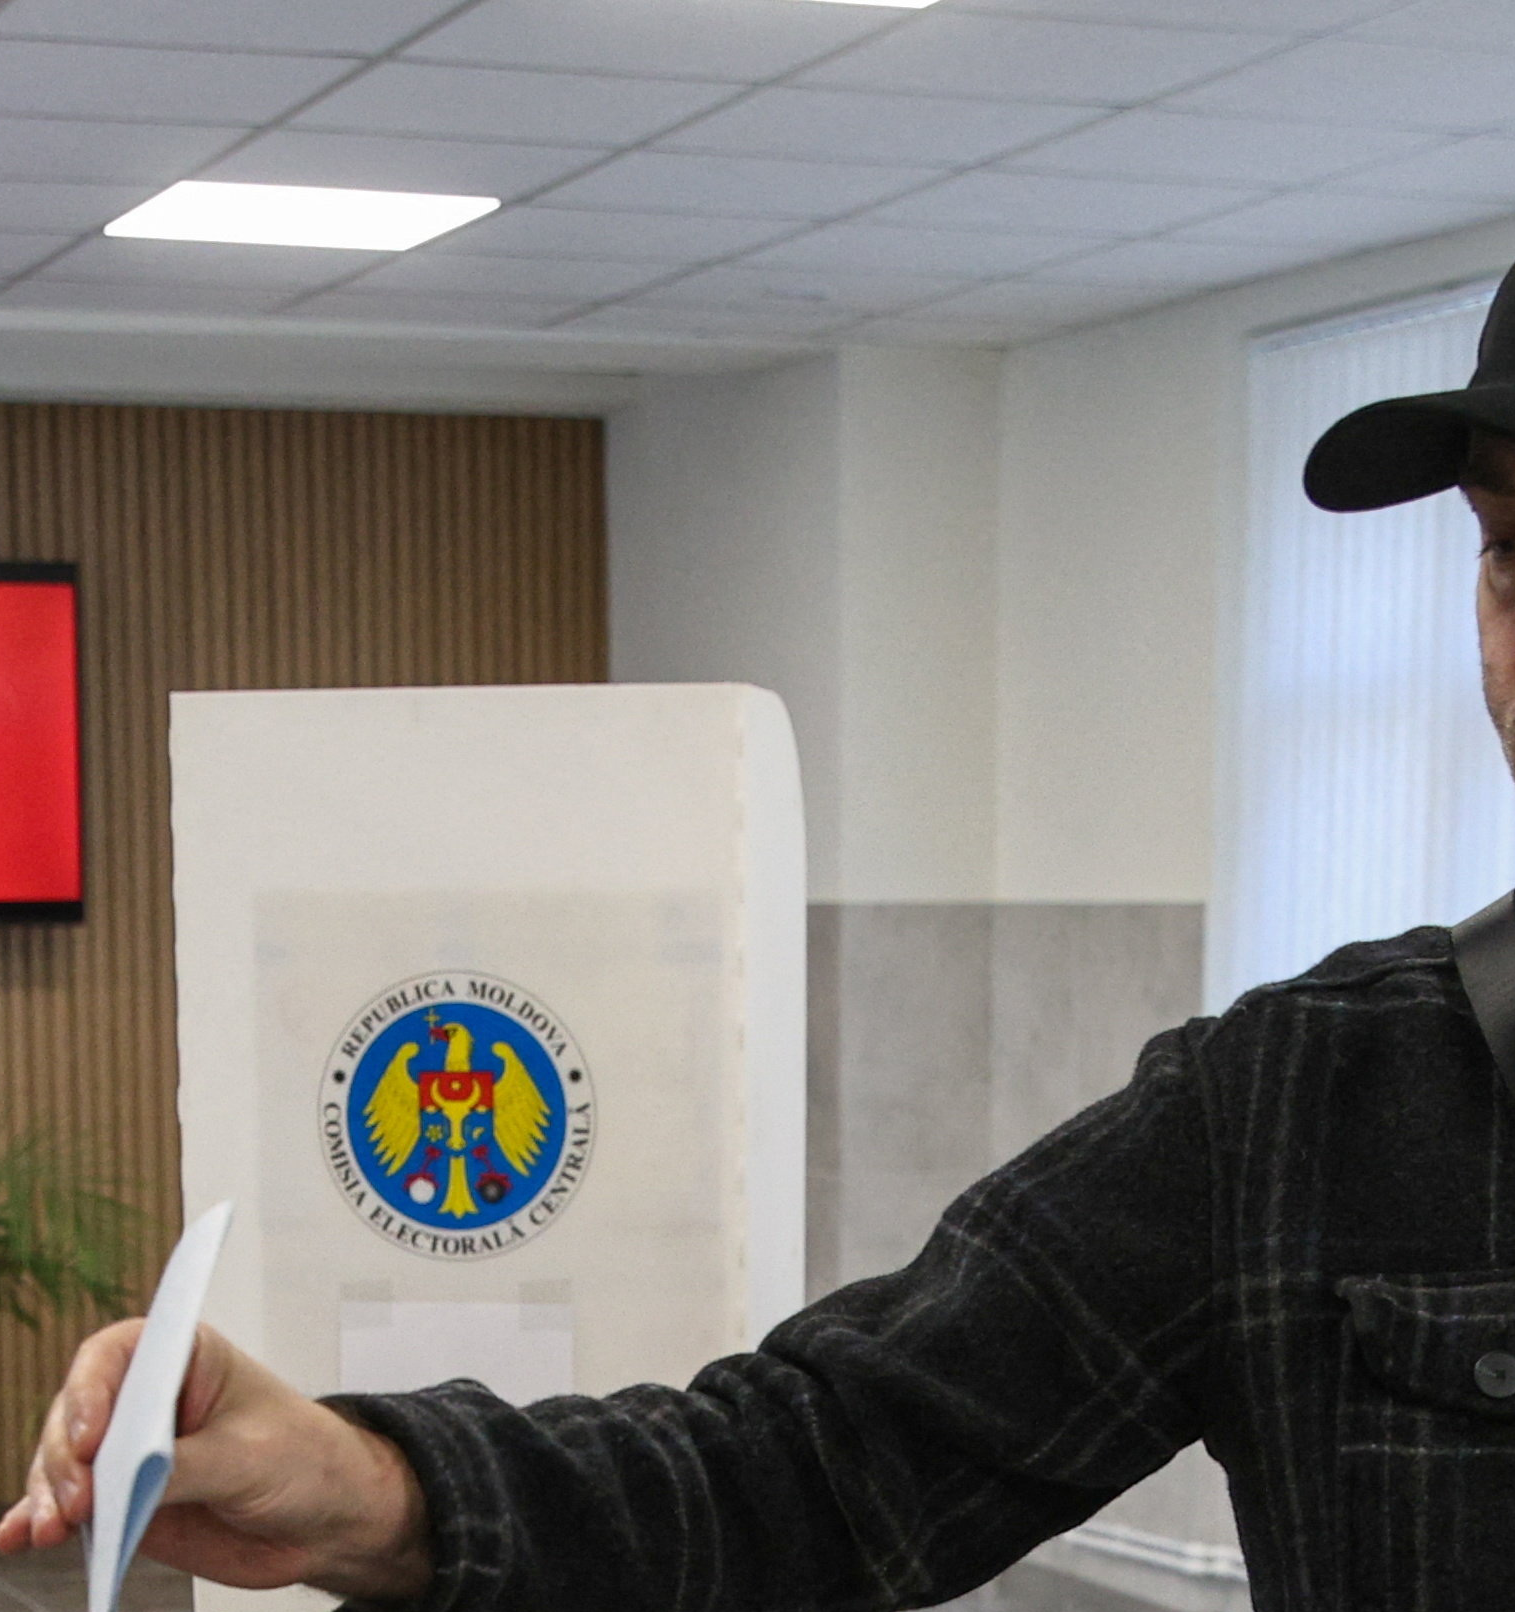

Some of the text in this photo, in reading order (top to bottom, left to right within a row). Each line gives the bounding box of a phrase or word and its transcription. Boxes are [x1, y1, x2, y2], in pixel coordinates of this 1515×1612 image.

[340, 980, 567, 1059] REPUBLICA MOLDOVA
[324, 1102, 366, 1208] COMISIA
